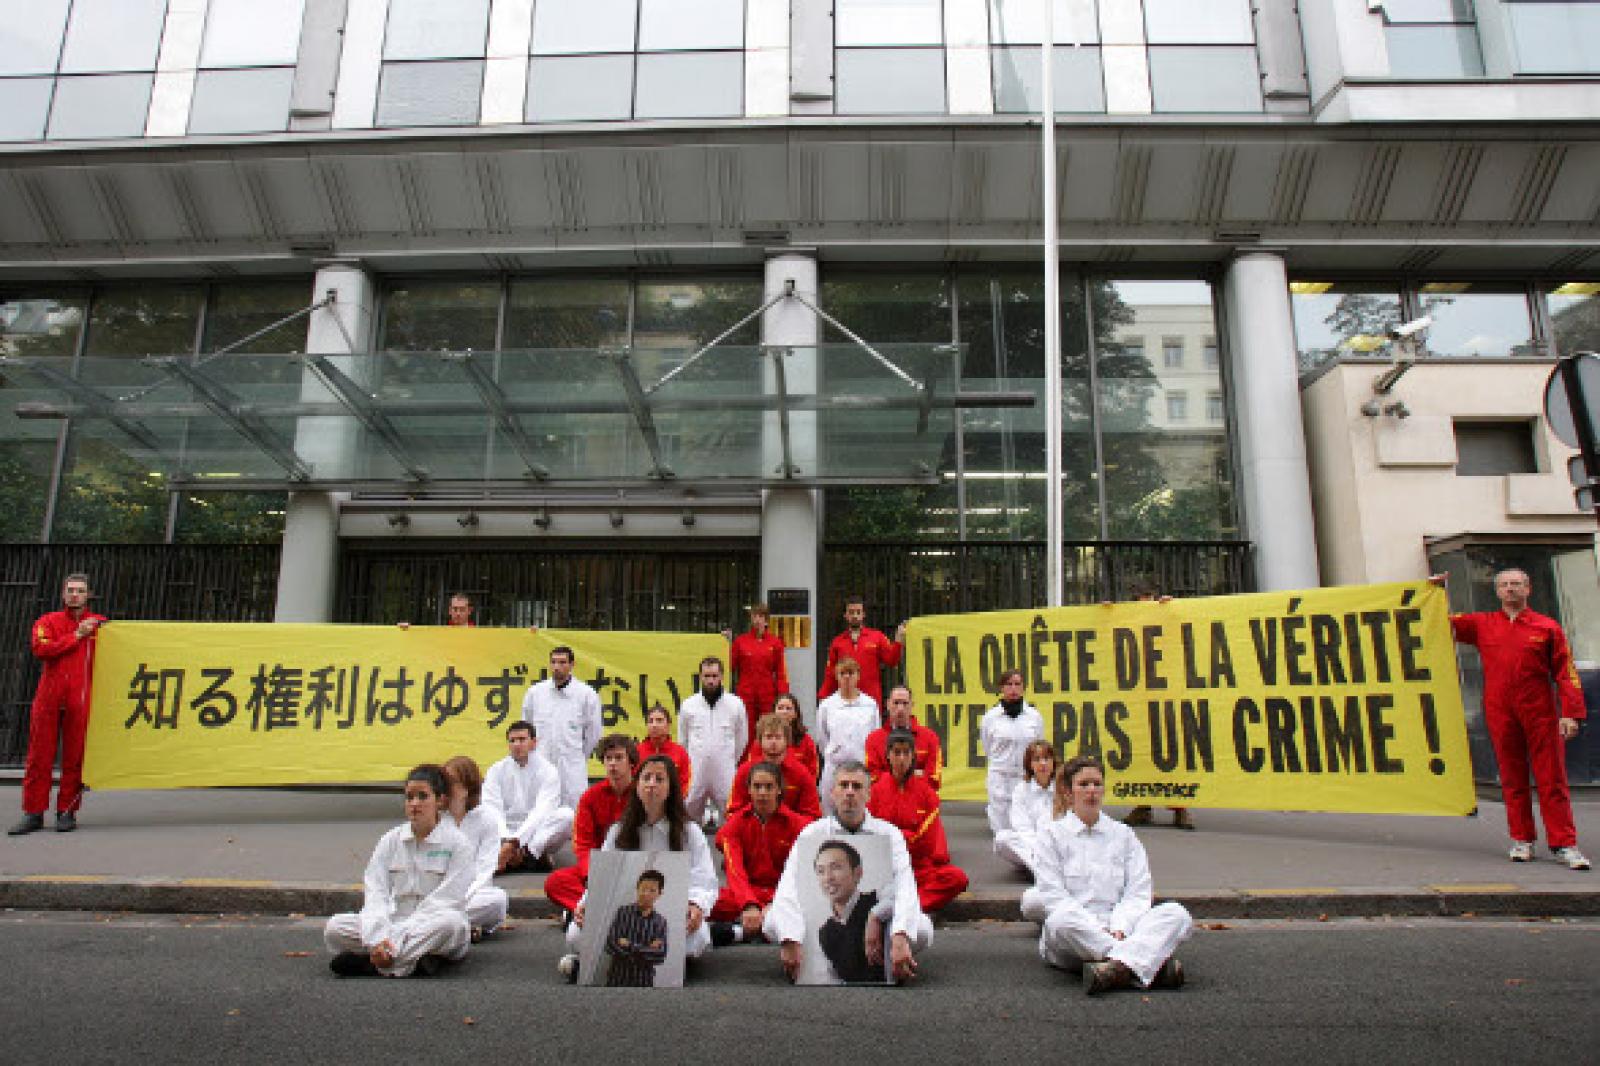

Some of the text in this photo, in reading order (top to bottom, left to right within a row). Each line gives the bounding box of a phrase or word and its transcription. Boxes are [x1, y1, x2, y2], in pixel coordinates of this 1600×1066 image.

[922, 590, 1432, 696] LA QUÊTE DE LA VÉRITÉ
[124, 662, 700, 730] 知る権利はゆずない
[1052, 701, 1132, 772] PAS
[1148, 699, 1214, 773] UN
[1232, 694, 1405, 776] CRIME
